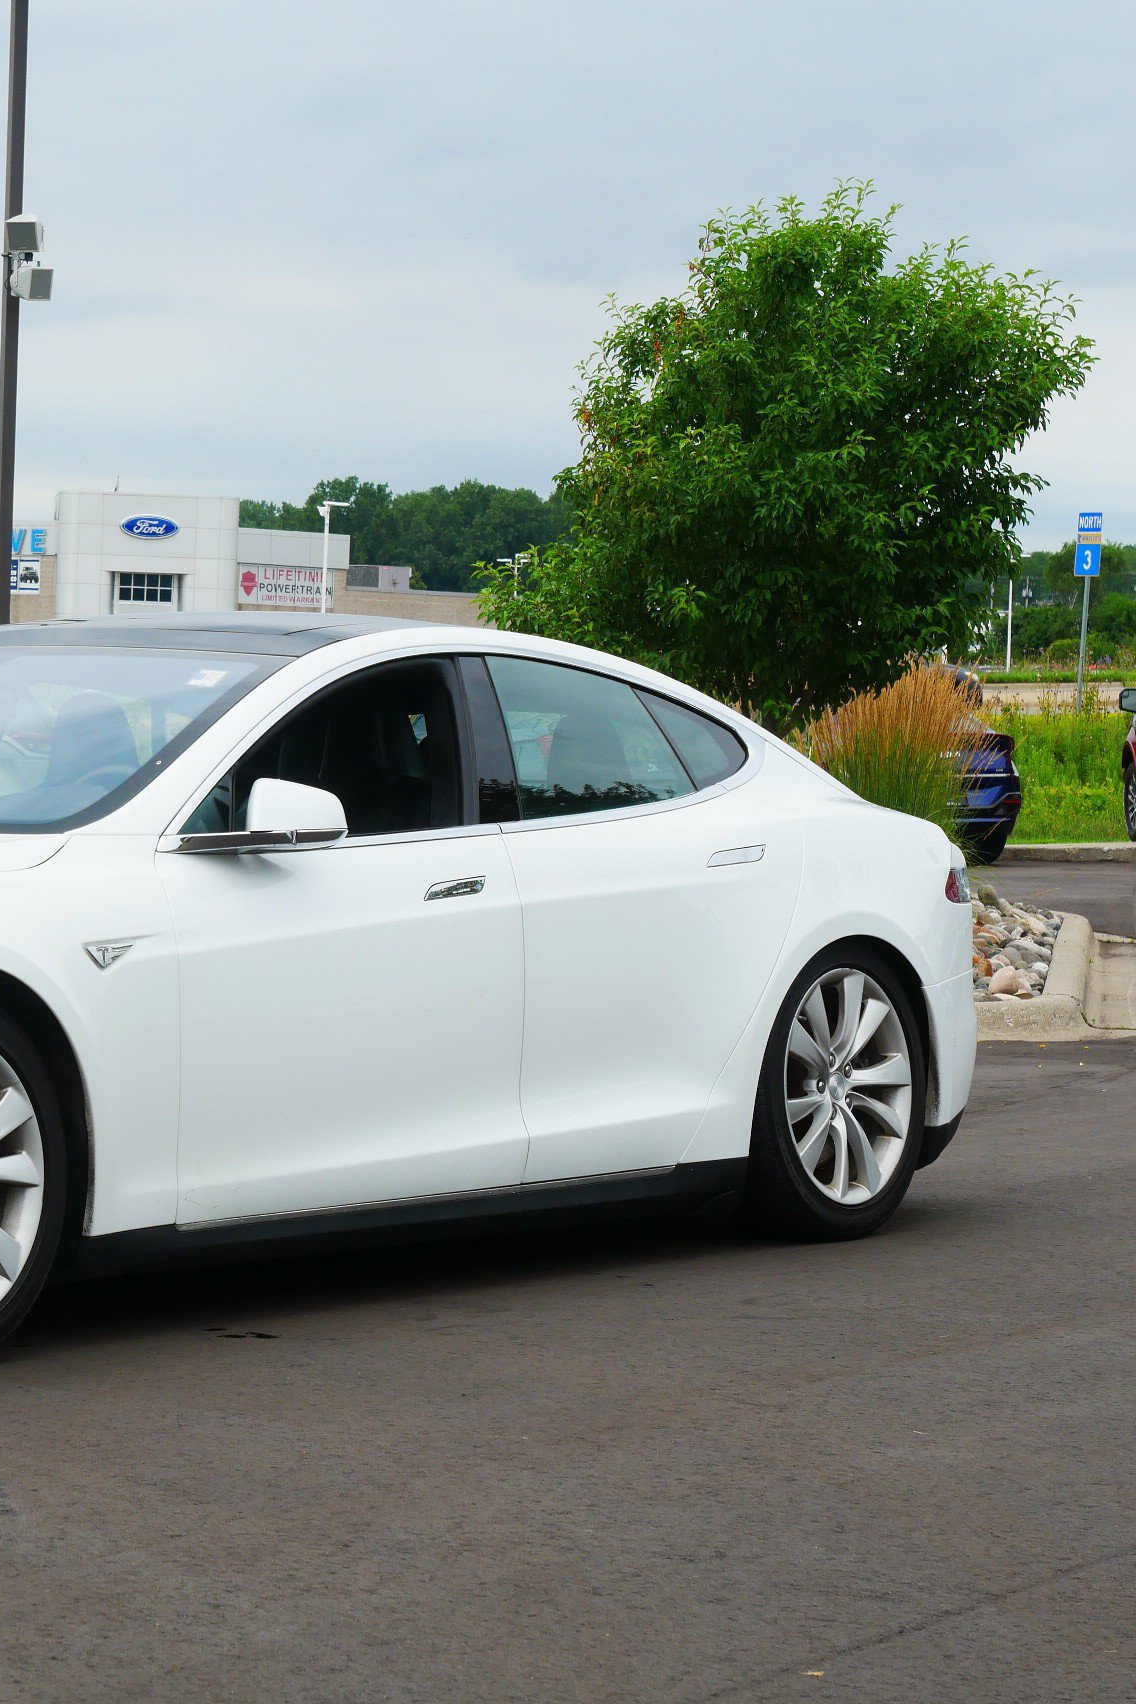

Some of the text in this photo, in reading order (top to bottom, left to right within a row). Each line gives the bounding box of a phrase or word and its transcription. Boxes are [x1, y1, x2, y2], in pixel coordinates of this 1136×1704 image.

[133, 519, 167, 534] Ford
[1079, 516, 1102, 528] NORTH
[1083, 550, 1092, 570] 3
[259, 583, 332, 596] POWERTRAN
